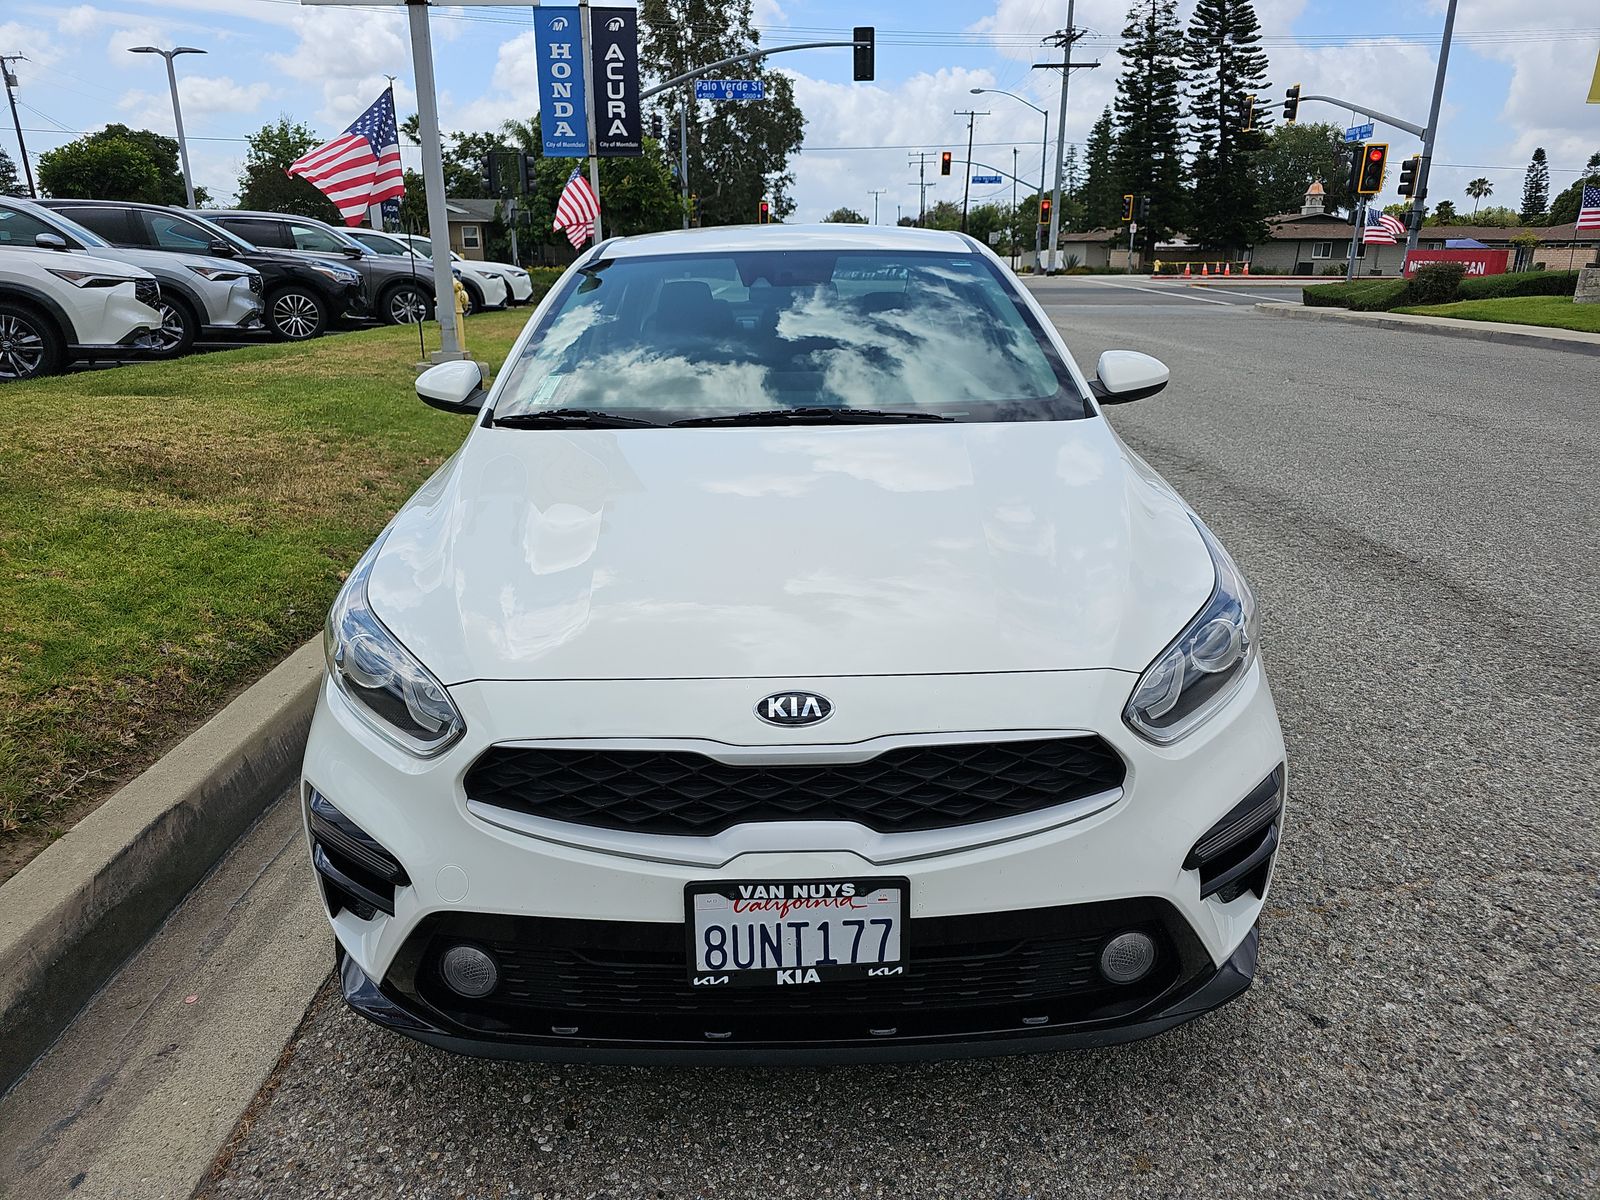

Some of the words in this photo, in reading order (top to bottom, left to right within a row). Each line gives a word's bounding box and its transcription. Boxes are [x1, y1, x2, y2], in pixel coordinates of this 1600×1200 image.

[549, 43, 576, 137] HONDA
[604, 43, 629, 137] ACURA
[696, 81, 717, 91] Palo
[720, 81, 748, 91] Verde
[751, 81, 762, 91] St
[546, 141, 555, 149] City
[767, 696, 823, 718] KIA
[738, 885, 785, 899] VAN
[793, 883, 856, 898] NUYS
[733, 896, 868, 919] California
[704, 918, 893, 970] 8UNT177
[776, 968, 821, 985] KIA
